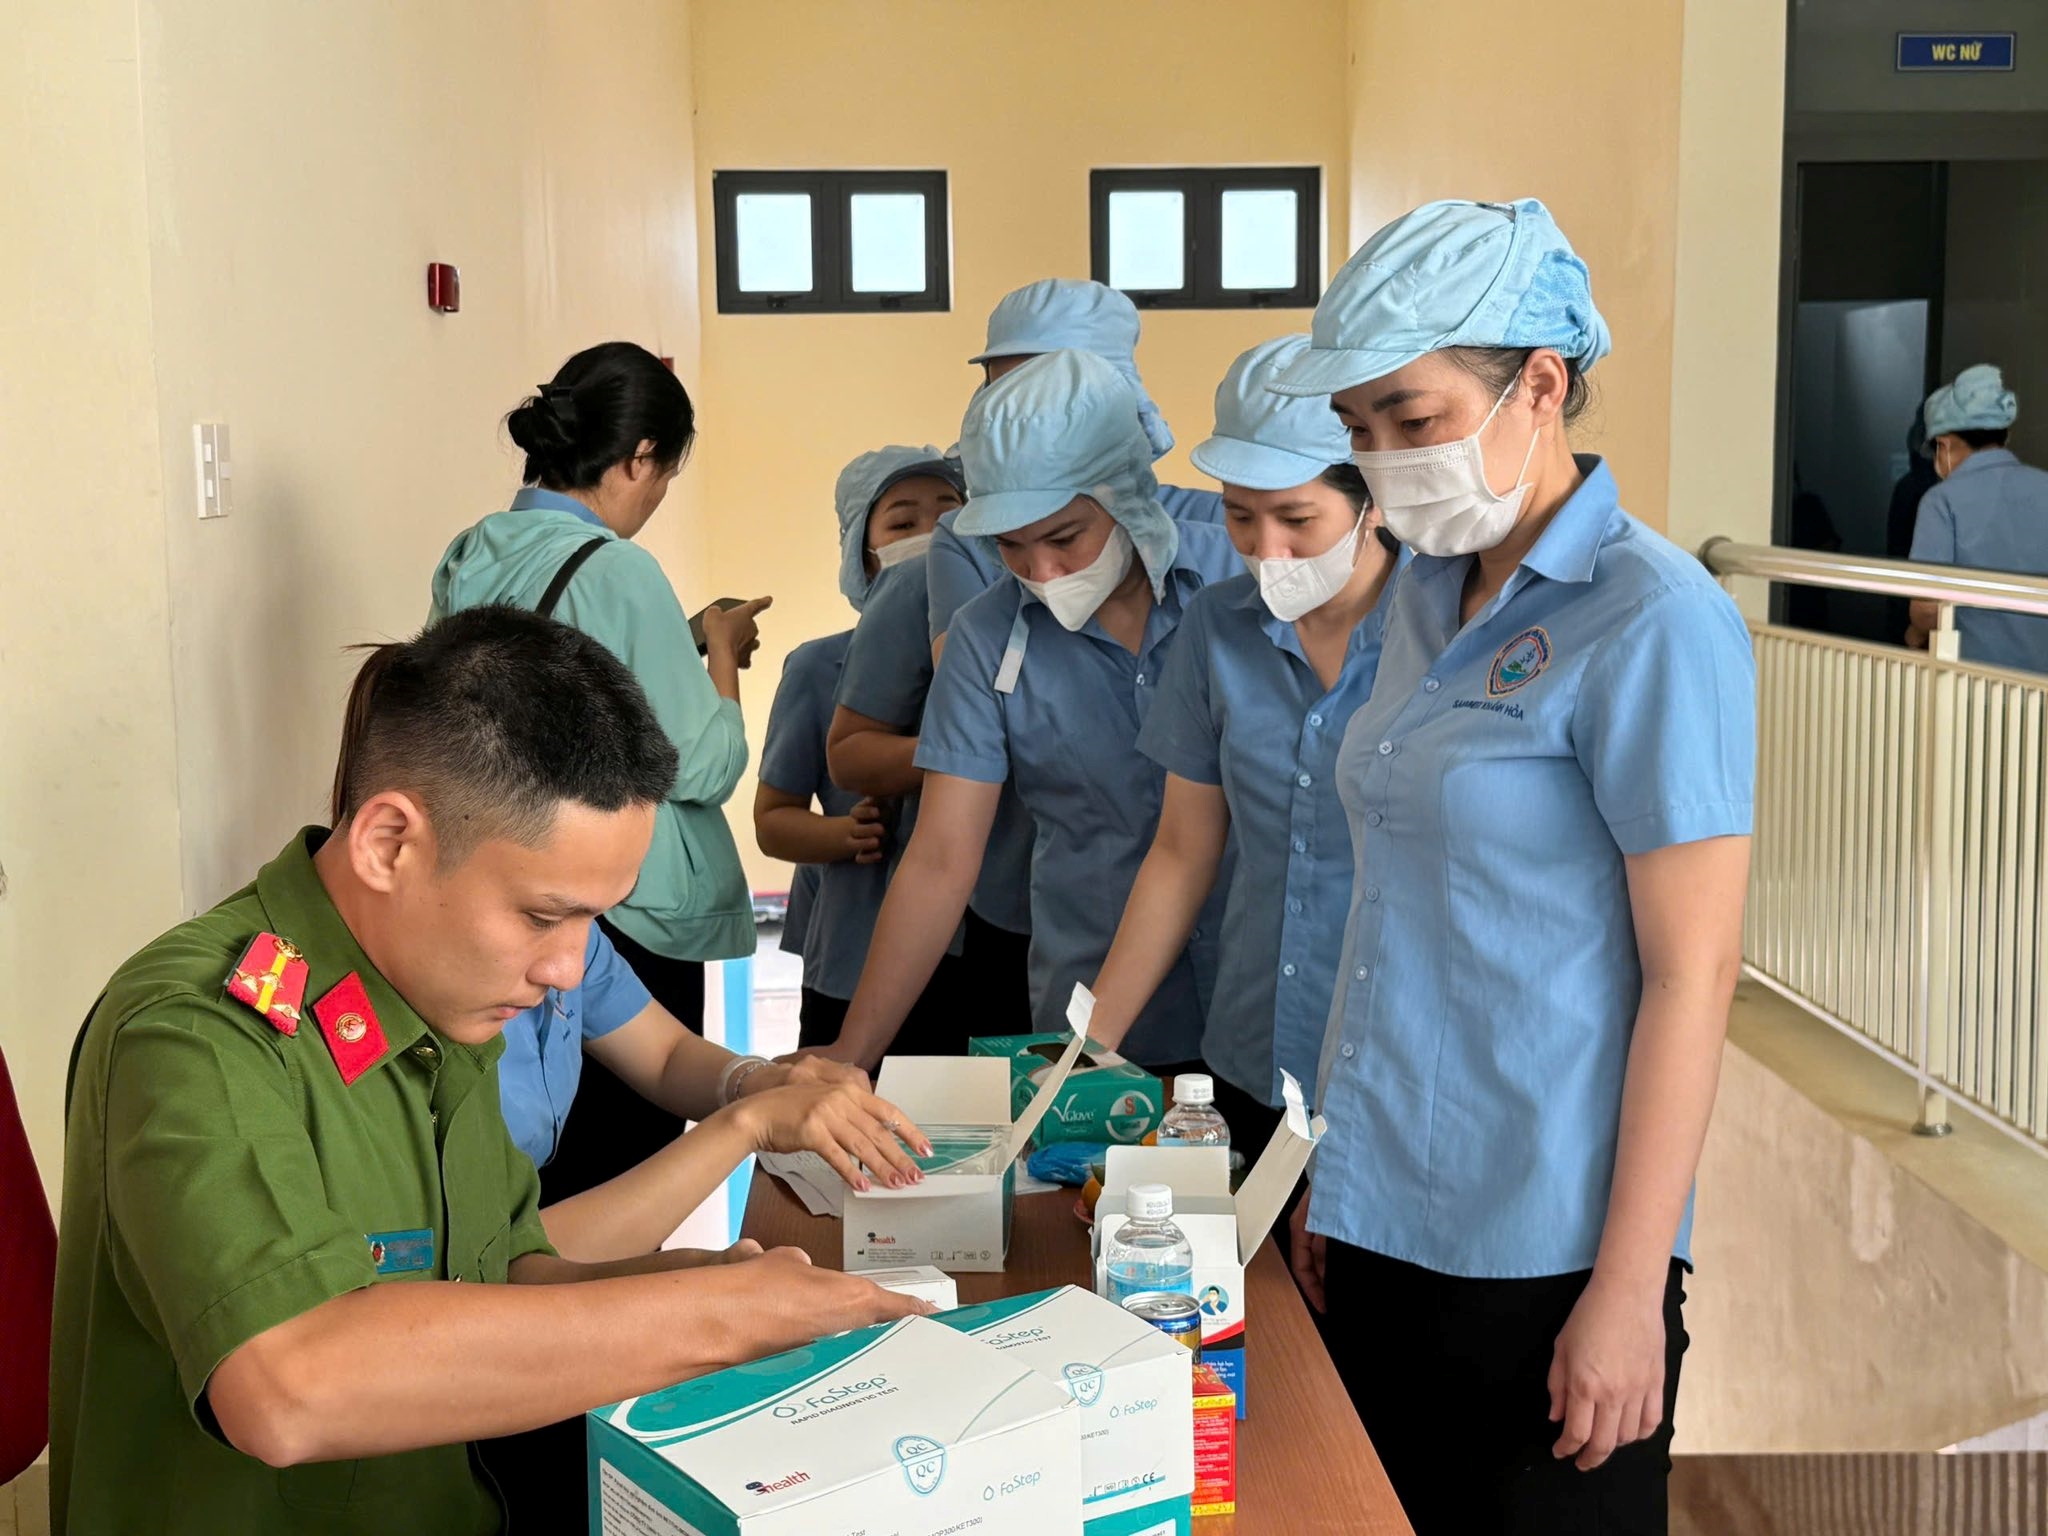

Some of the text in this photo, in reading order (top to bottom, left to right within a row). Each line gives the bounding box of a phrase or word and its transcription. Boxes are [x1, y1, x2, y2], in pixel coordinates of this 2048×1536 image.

[1932, 40, 1983, 61] WC NỮ
[1125, 1096, 1136, 1116] S
[980, 1328, 1044, 1346] aStep
[806, 1377, 887, 1408] FaStep
[1080, 1380, 1096, 1393] QC
[790, 1386, 900, 1425] RAPID DIAGNOSTIC TEST
[1124, 1398, 1158, 1416] FaStep
[906, 1442, 929, 1455] QC
[916, 1461, 936, 1478] QC
[1000, 1471, 1041, 1496] FaStep
